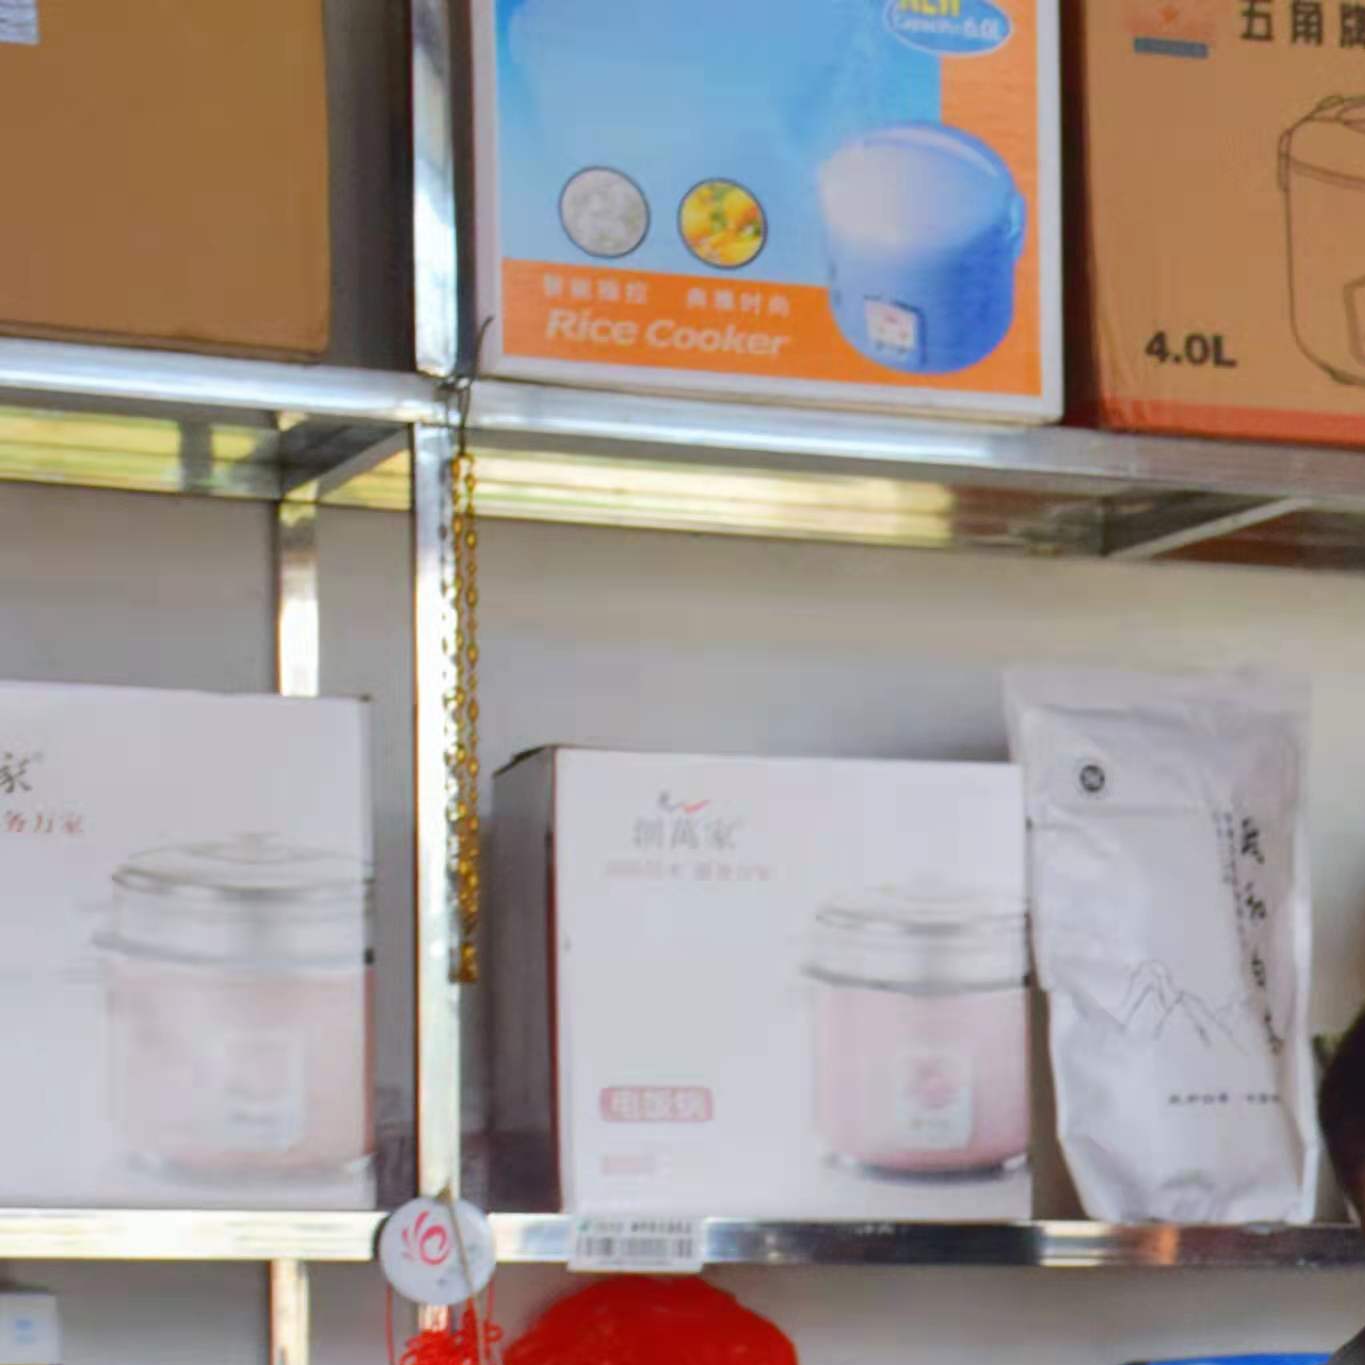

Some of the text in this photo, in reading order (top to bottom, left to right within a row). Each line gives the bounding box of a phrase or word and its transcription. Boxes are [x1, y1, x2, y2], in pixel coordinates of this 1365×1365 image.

[545, 306, 790, 358] Rice Cooker
[1144, 330, 1239, 368] 4.0L
